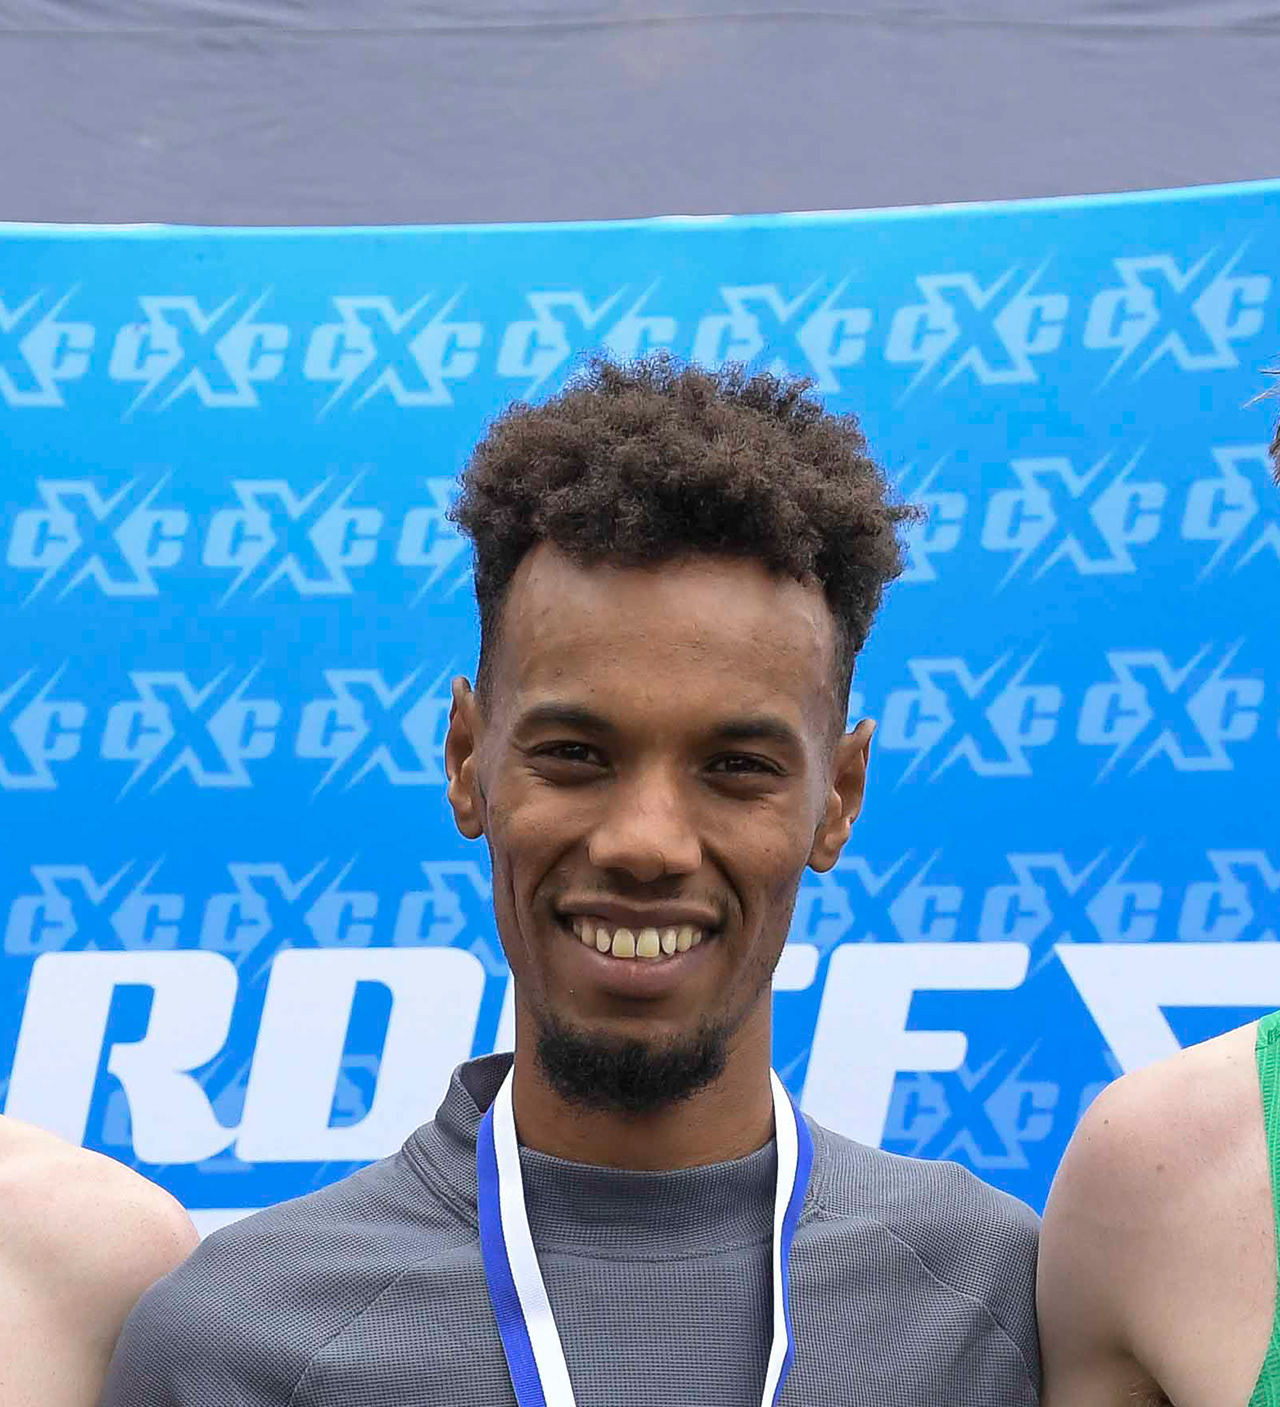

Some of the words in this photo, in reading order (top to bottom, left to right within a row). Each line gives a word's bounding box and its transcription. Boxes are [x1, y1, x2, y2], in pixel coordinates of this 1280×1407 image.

[110, 296, 289, 406] CXC
[304, 296, 483, 406] CXC
[886, 274, 1068, 383] CXC
[1084, 256, 1272, 370] CXC
[8, 480, 187, 596] CXC
[202, 481, 381, 595] CXC
[982, 458, 1166, 573] CXC
[101, 672, 281, 787] CXC
[880, 659, 1062, 777] CXC
[1077, 651, 1265, 770] CXC
